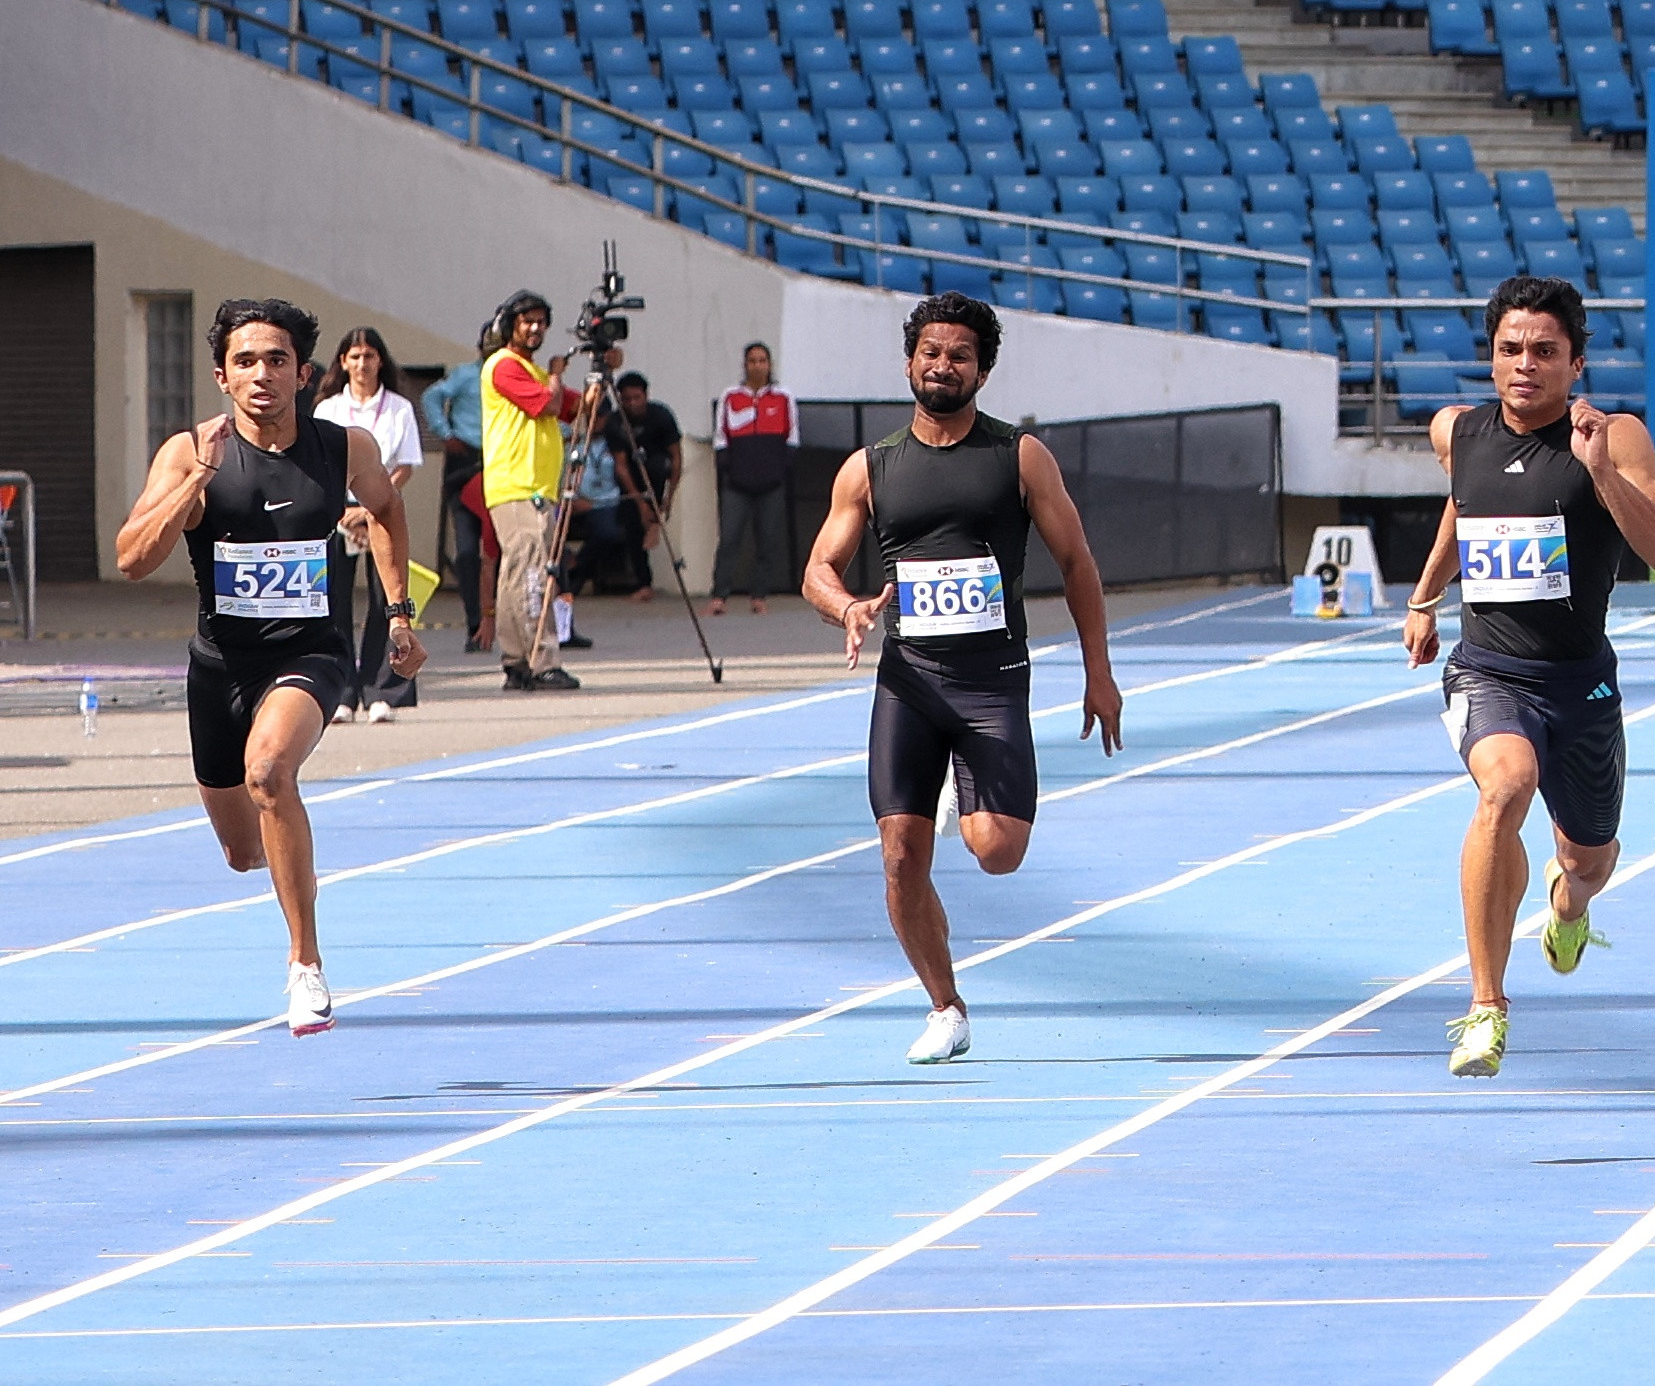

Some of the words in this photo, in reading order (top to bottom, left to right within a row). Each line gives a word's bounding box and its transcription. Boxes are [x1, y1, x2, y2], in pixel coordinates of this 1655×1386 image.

[1323, 536, 1352, 566] 10
[1467, 539, 1546, 580] 514
[233, 561, 312, 598] 524
[912, 578, 986, 617] 866
